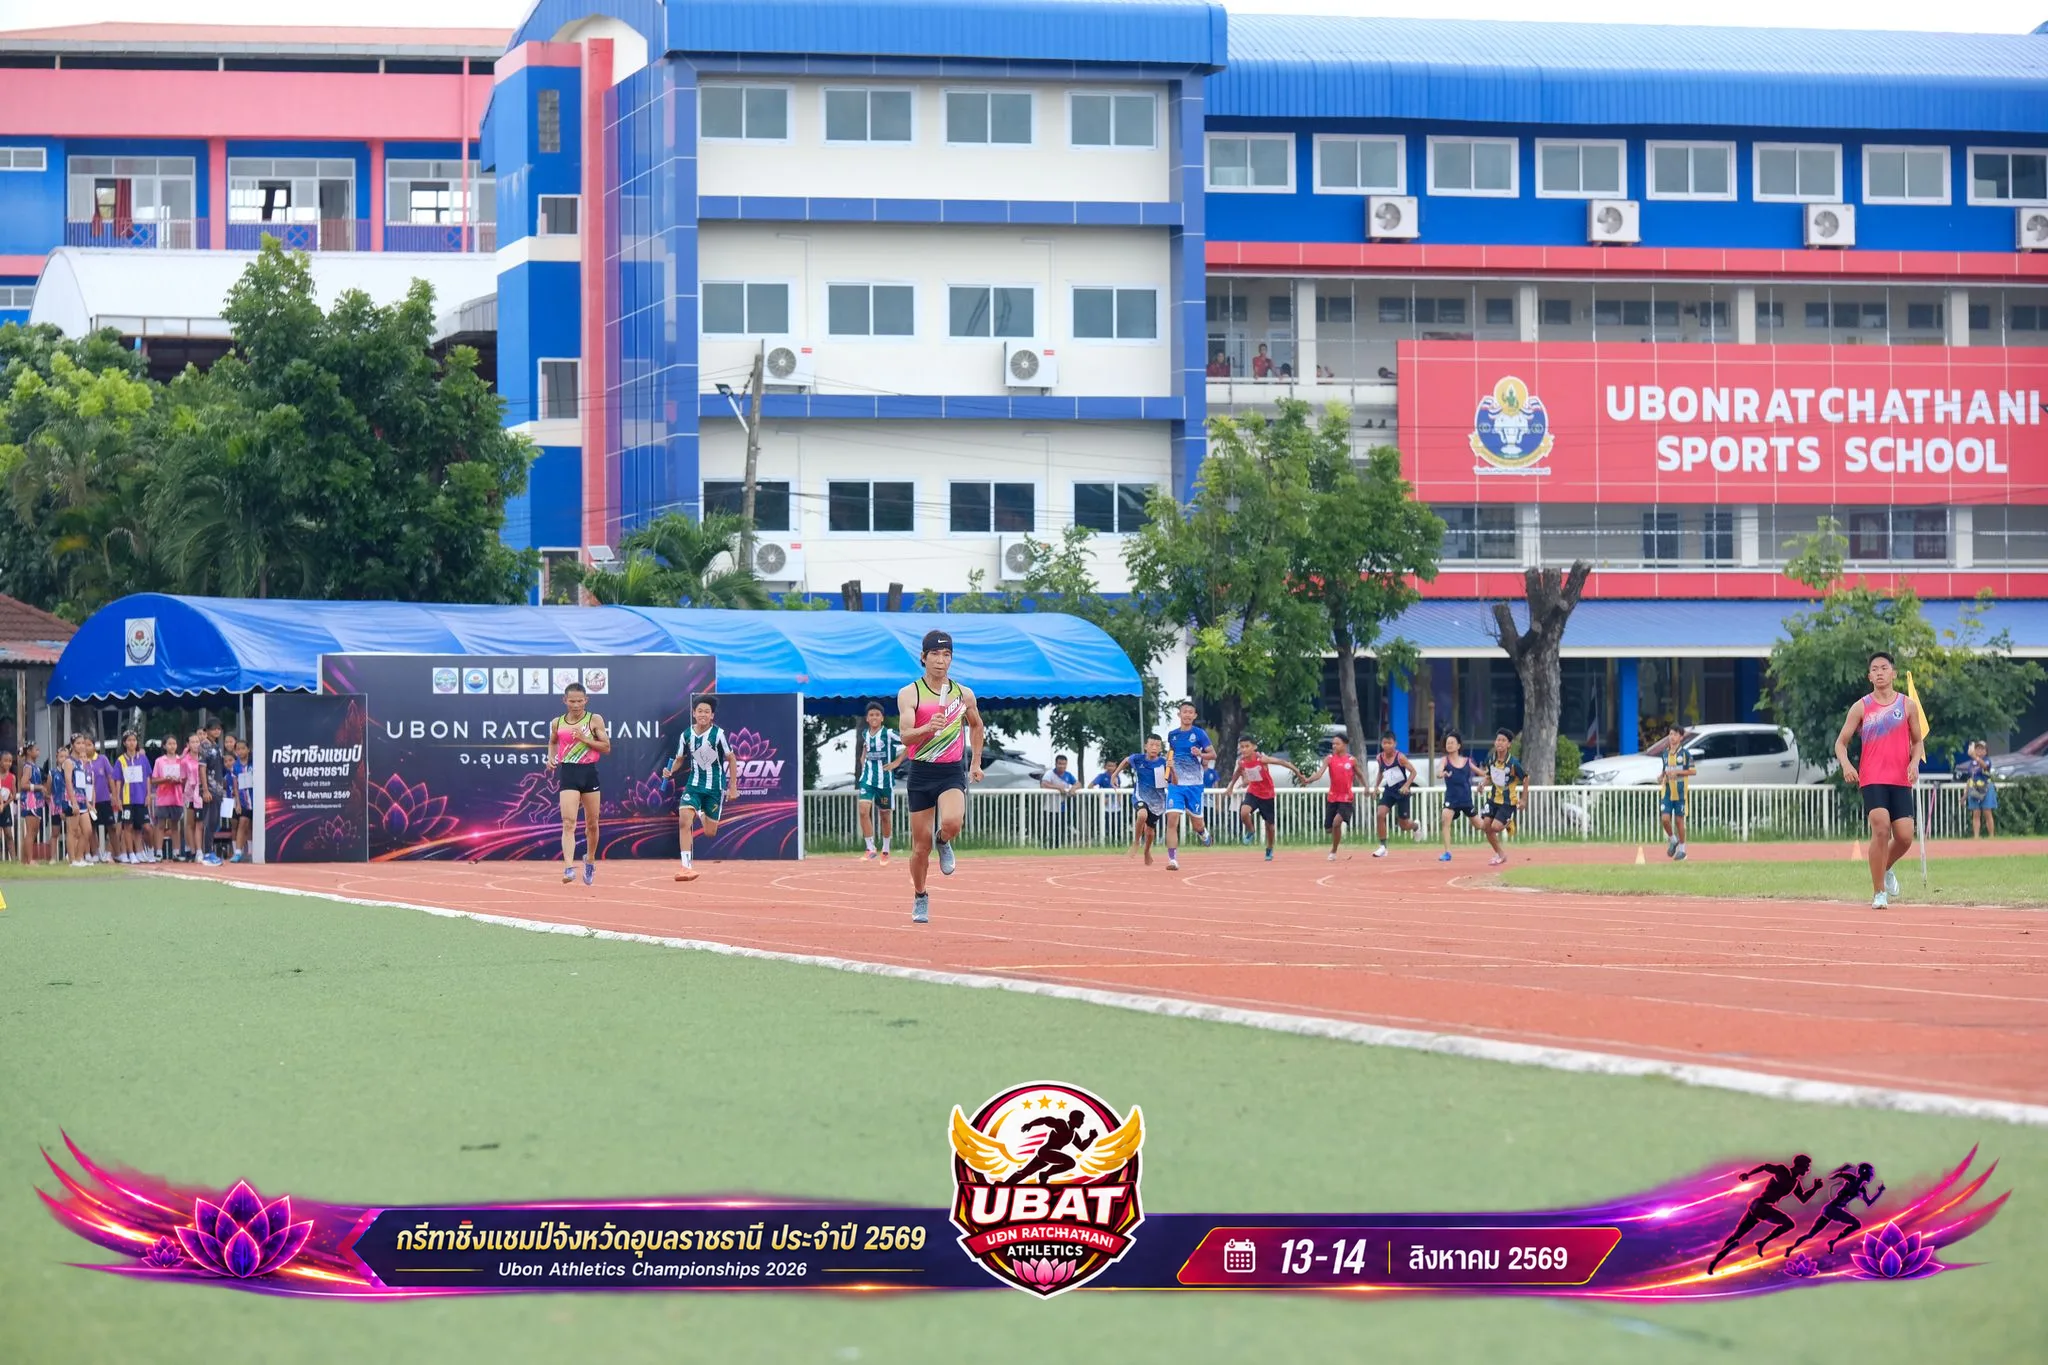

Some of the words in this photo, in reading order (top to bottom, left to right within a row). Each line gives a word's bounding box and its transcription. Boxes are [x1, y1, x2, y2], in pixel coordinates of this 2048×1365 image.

[1606, 385, 2040, 425] UBONRATCHATHANI
[1657, 436, 1820, 472] SPORTS
[1845, 437, 2008, 474] SCHOOL
[386, 720, 469, 739] UBON
[482, 720, 660, 739] RATCHANI
[283, 791, 306, 800] 12-14
[333, 790, 351, 800] 2569
